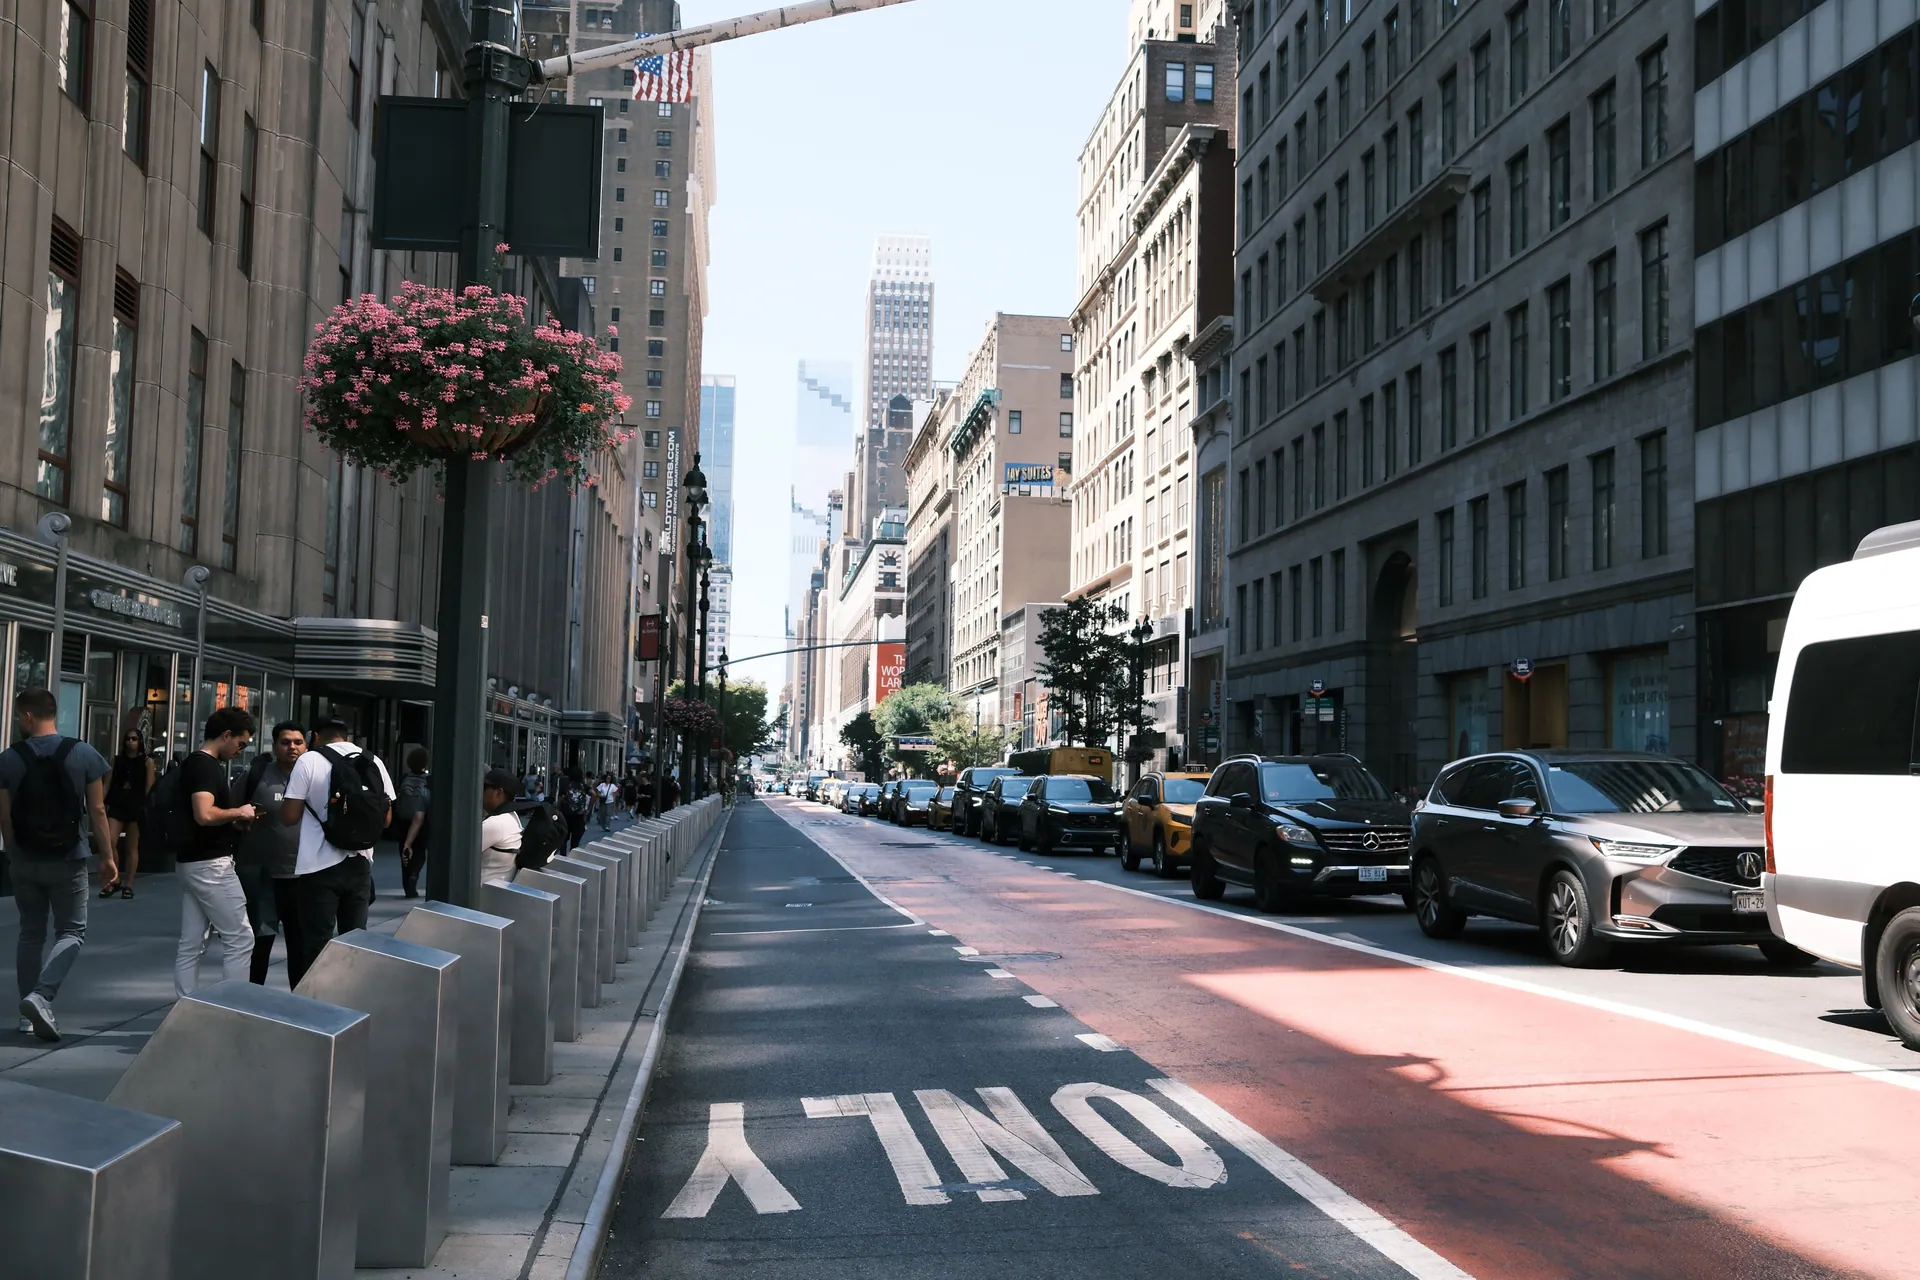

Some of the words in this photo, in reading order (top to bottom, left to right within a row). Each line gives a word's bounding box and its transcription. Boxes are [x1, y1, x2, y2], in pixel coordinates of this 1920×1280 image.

[665, 431, 675, 550] ALDTOWERS.COM
[1021, 465, 1052, 481] SUITES
[881, 677, 902, 688] LAR
[660, 1082, 1228, 1218] ONLY
